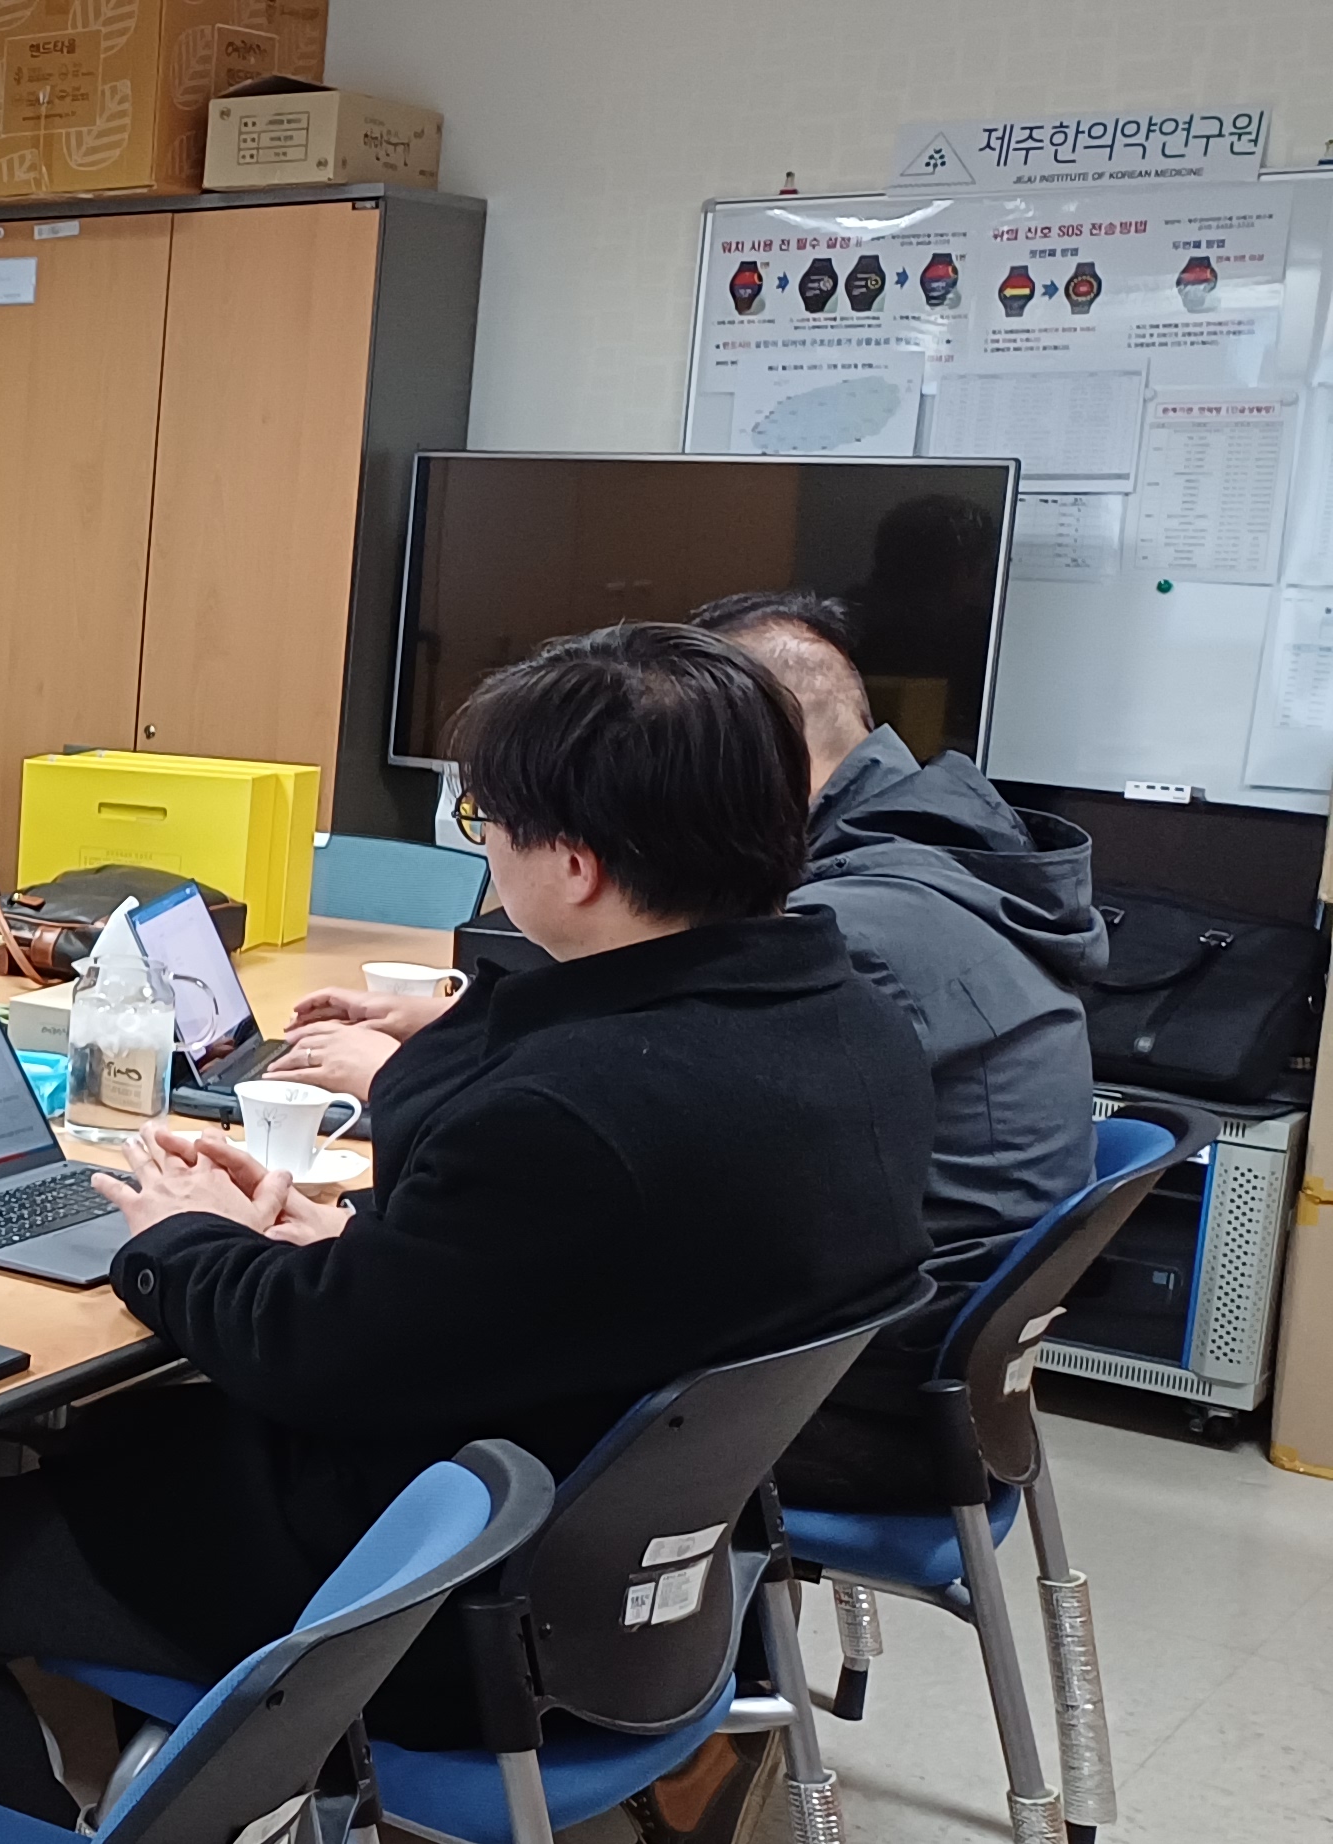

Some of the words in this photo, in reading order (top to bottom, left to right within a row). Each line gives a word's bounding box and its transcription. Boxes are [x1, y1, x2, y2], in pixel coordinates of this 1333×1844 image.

[978, 110, 1265, 167] 제주한의약연구원
[1039, 172, 1089, 184] INSTITUTE
[1091, 171, 1106, 181] OF
[1108, 169, 1152, 180] KOREAN
[1154, 167, 1205, 178] MEDICINE
[1057, 224, 1084, 238] SOS
